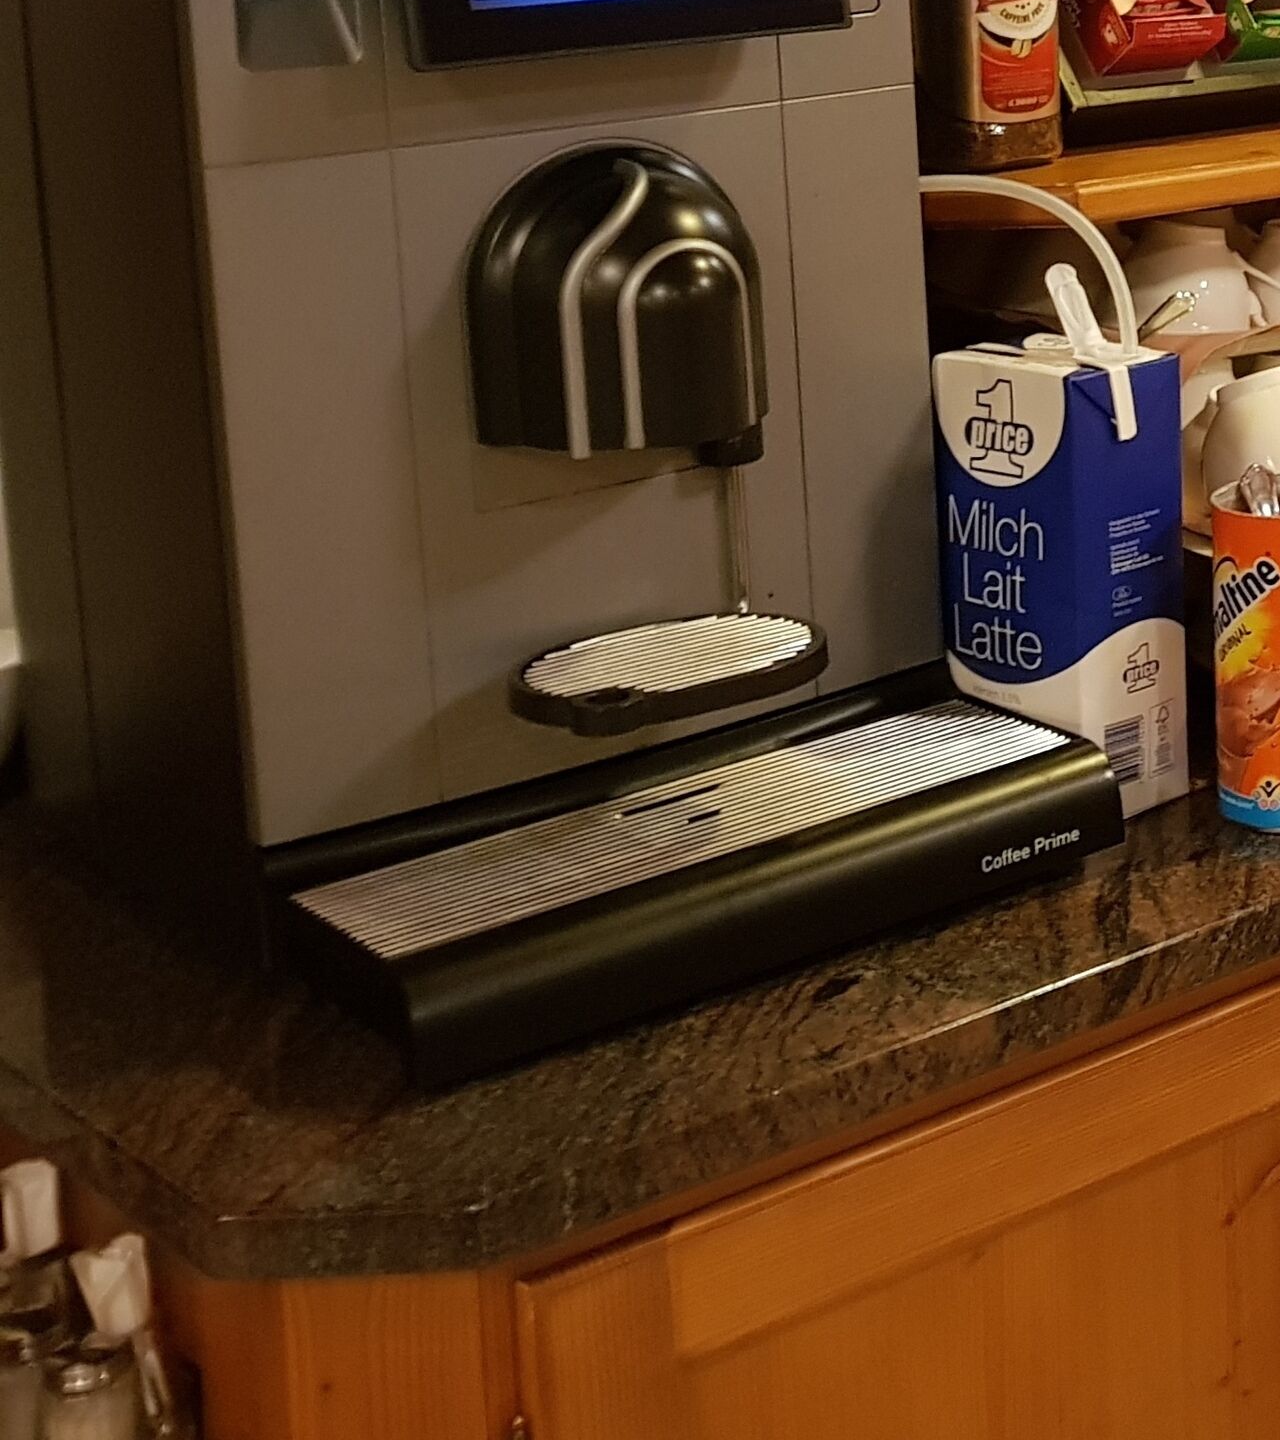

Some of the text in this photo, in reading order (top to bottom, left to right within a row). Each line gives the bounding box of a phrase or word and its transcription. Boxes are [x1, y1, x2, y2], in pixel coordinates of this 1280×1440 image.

[1000, 7, 1031, 24] CAFFEINE
[969, 419, 1030, 456] price
[948, 493, 1044, 561] Milch
[963, 551, 1026, 613] Lait
[953, 602, 1043, 670] Latte
[981, 828, 1081, 873] Coffee Prime
